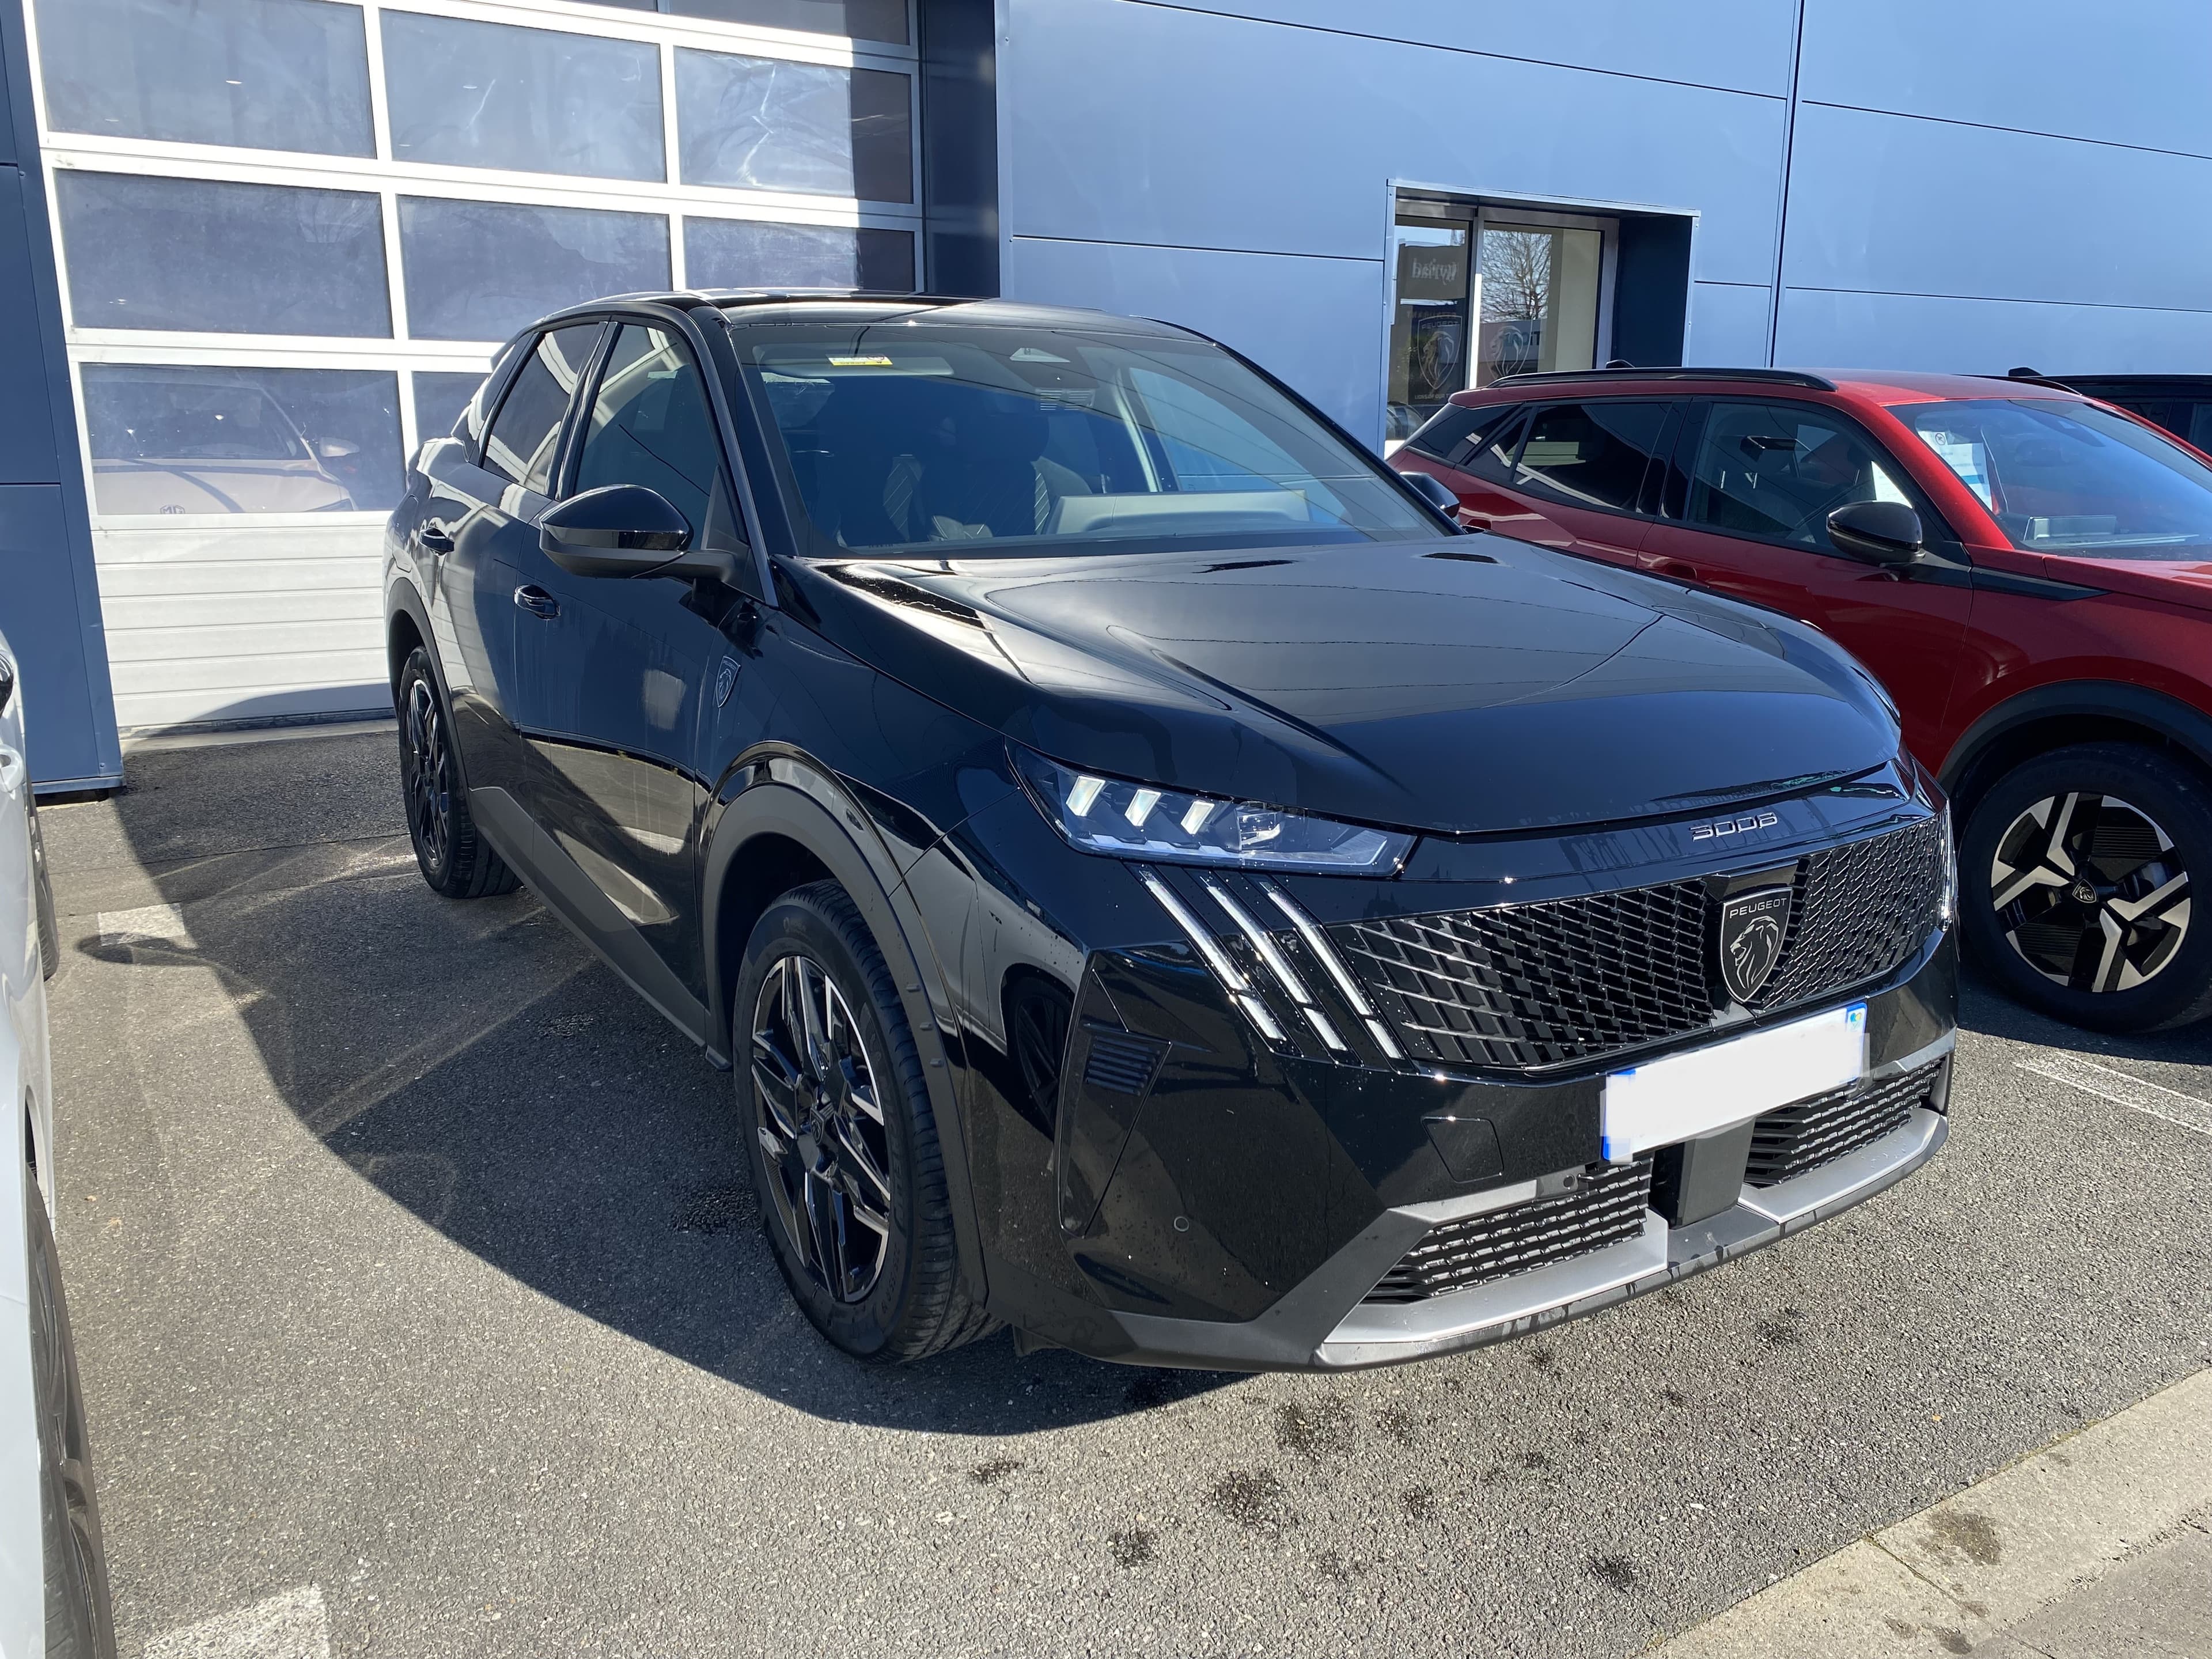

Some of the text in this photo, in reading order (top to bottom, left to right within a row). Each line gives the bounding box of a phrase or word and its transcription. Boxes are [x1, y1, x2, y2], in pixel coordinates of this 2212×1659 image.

[1421, 321, 1459, 329] PEUGEOT
[1688, 811, 1778, 843] 3008
[1729, 898, 1787, 919] PEUGEOT
